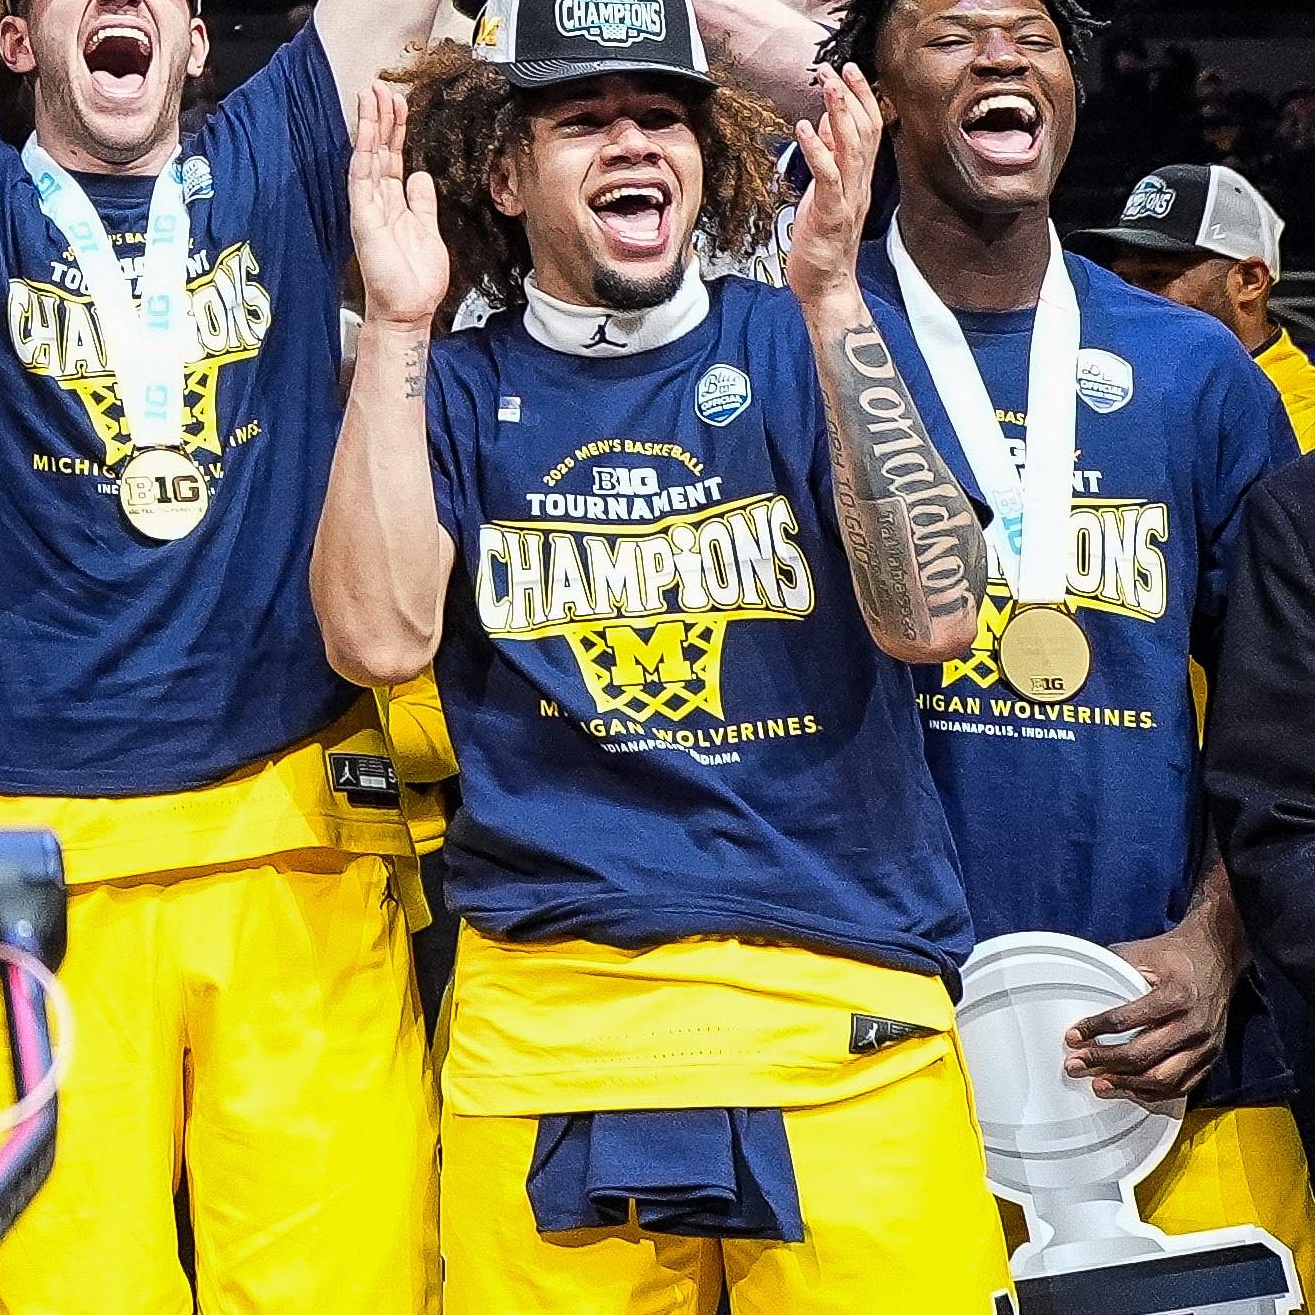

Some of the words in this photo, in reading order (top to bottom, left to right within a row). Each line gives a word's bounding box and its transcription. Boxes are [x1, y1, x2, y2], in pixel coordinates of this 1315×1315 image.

[542, 457, 575, 487] 2025
[575, 439, 622, 461] MEN'S
[526, 476, 722, 520] TOURNAMENT
[476, 495, 815, 633] CHAMPIONS
[605, 620, 693, 686] M
[652, 715, 818, 748] WOLVERINES
[990, 698, 1154, 728] WOLVERINES
[1021, 727, 1076, 741] INDIANA
